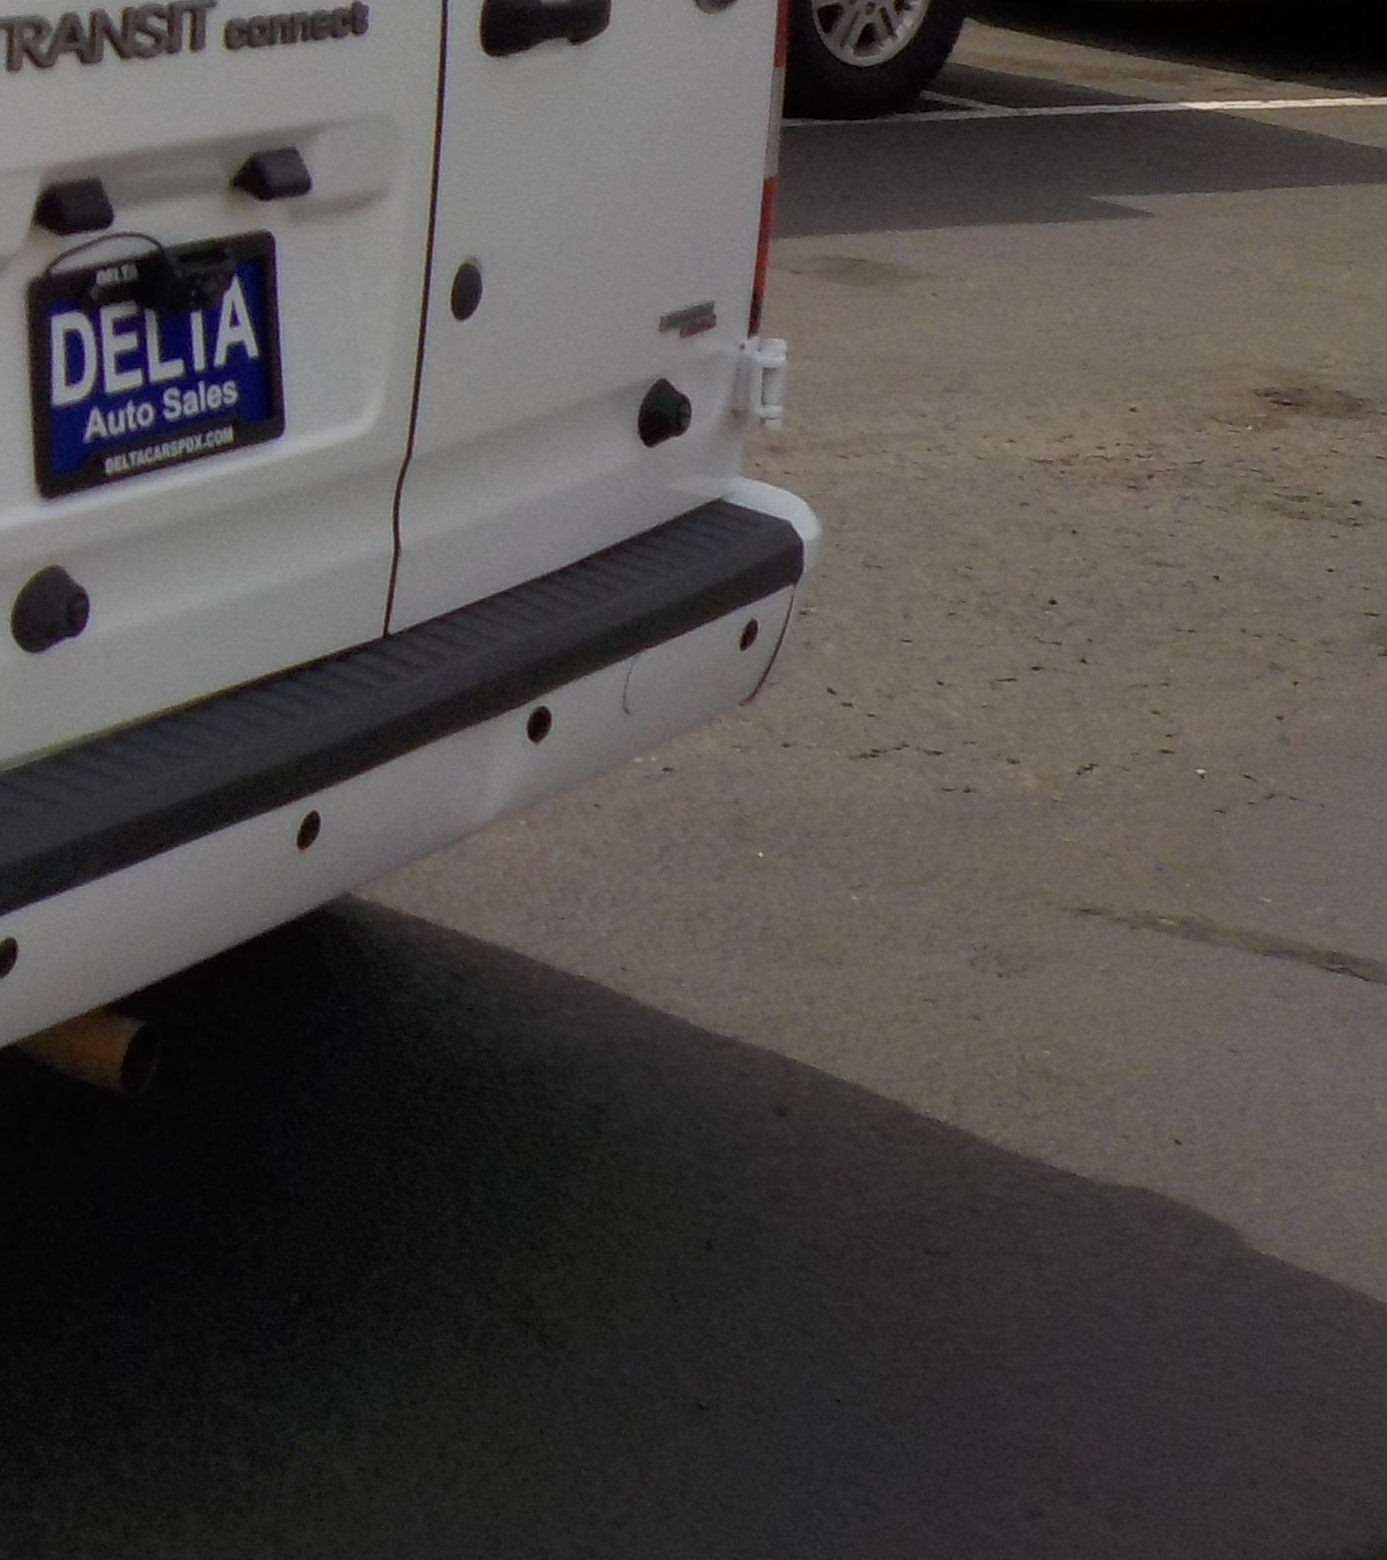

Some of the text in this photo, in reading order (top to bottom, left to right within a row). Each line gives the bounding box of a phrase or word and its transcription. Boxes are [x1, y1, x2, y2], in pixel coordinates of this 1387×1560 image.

[224, 0, 370, 50] connect
[83, 379, 239, 443] Auto Sales
[103, 425, 235, 476] DELTACARSPDX.COM
